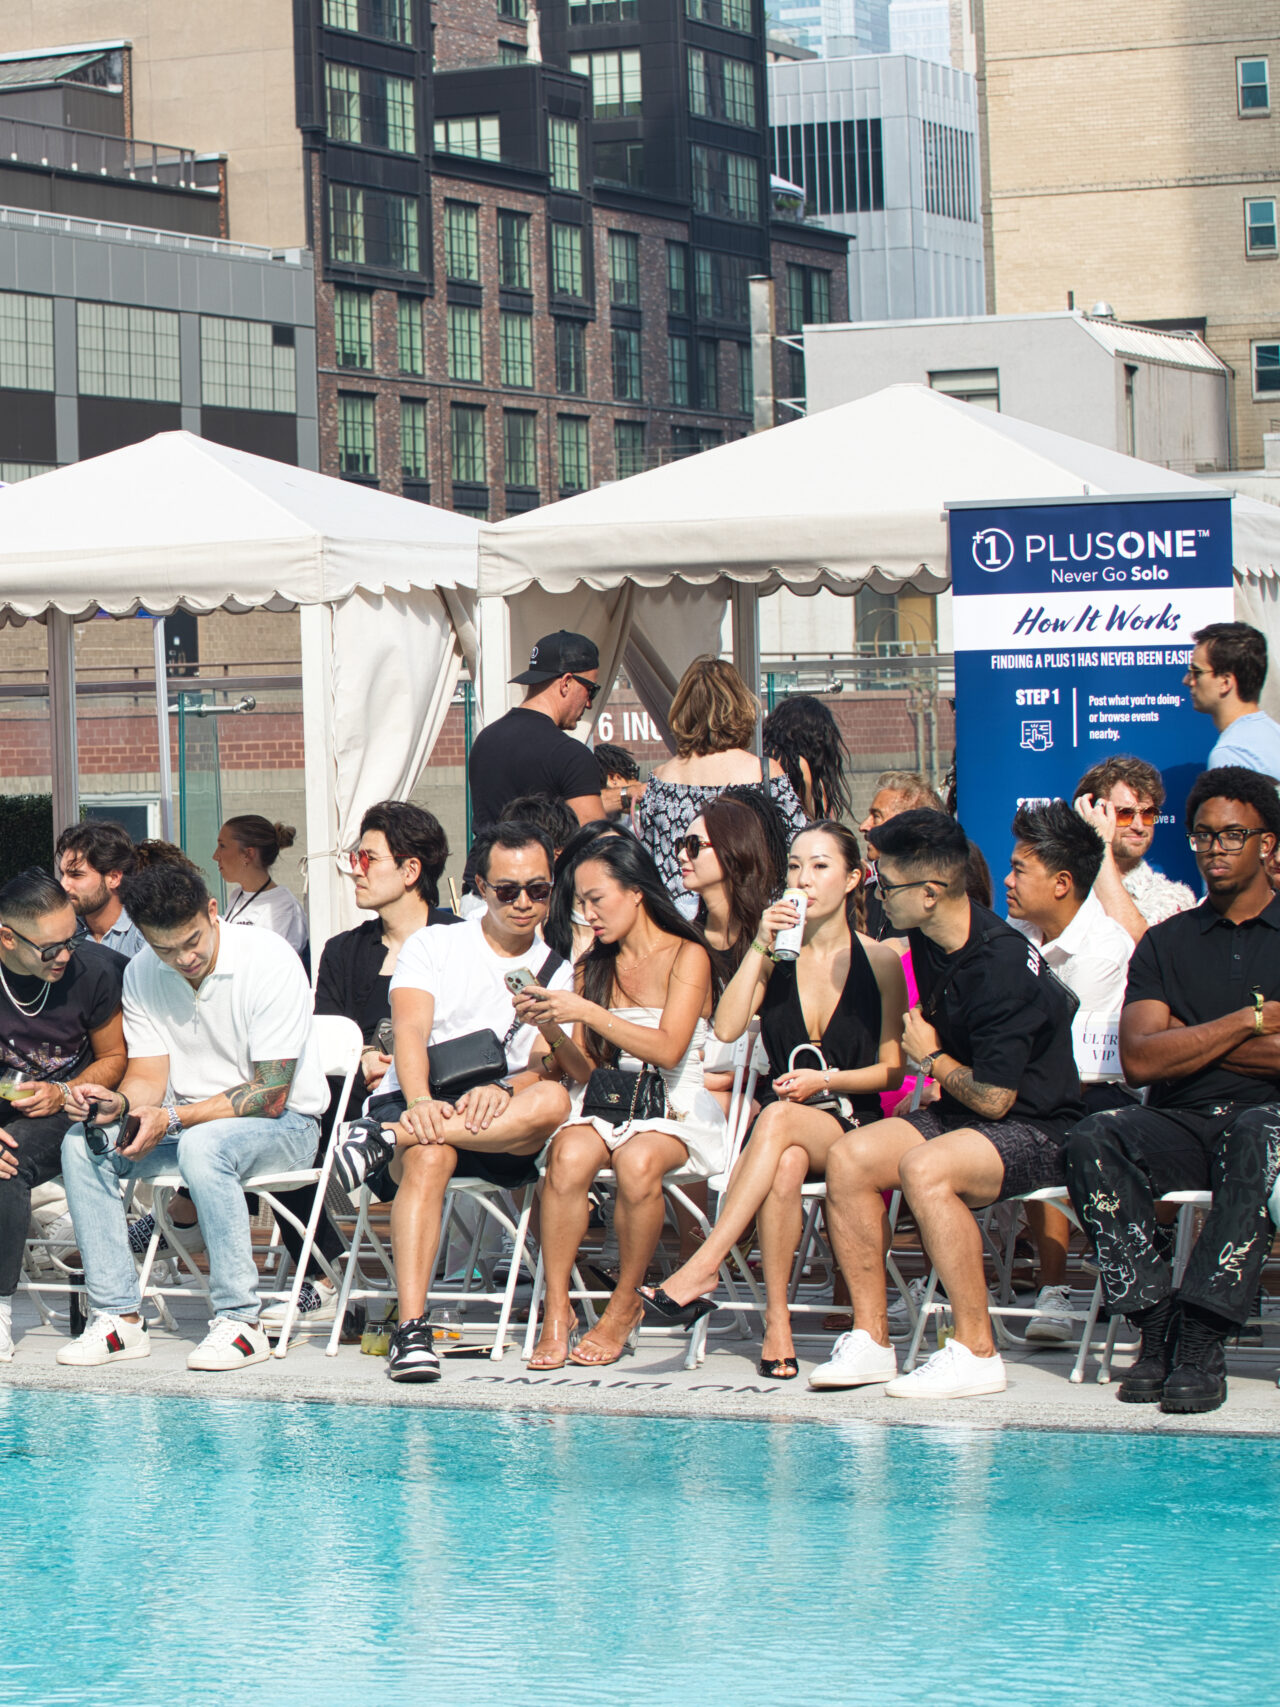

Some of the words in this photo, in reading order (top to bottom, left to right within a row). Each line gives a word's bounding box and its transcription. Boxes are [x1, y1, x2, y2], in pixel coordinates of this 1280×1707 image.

[1051, 568, 1098, 584] Never
[1102, 567, 1127, 582] Go
[1131, 565, 1169, 581] Solo
[1012, 606, 1074, 636] How
[1073, 604, 1102, 632] It
[1105, 602, 1181, 633] Works
[991, 654, 1034, 670] FINDING
[1035, 654, 1043, 668] A
[1044, 653, 1070, 668] PLUS
[1077, 653, 1099, 667] HAS
[1100, 652, 1135, 667] NEVER
[1137, 651, 1163, 665] BEEN
[1165, 650, 1194, 665] EASIE
[1016, 688, 1050, 706] STEP
[1053, 689, 1059, 704] 1
[1089, 694, 1109, 707] Post
[1109, 695, 1131, 706] what
[1131, 694, 1156, 709] you're
[1157, 692, 1180, 708] doing
[1089, 713, 1098, 722] or
[1100, 711, 1129, 723] browse
[1131, 711, 1159, 722] events
[598, 712, 614, 742] 6
[1089, 728, 1120, 741] nearby.
[1082, 1032, 1119, 1046] ULTR
[1092, 1050, 1116, 1062] VIP
[463, 1375, 674, 1391] DIVING
[688, 1384, 782, 1395] NO
